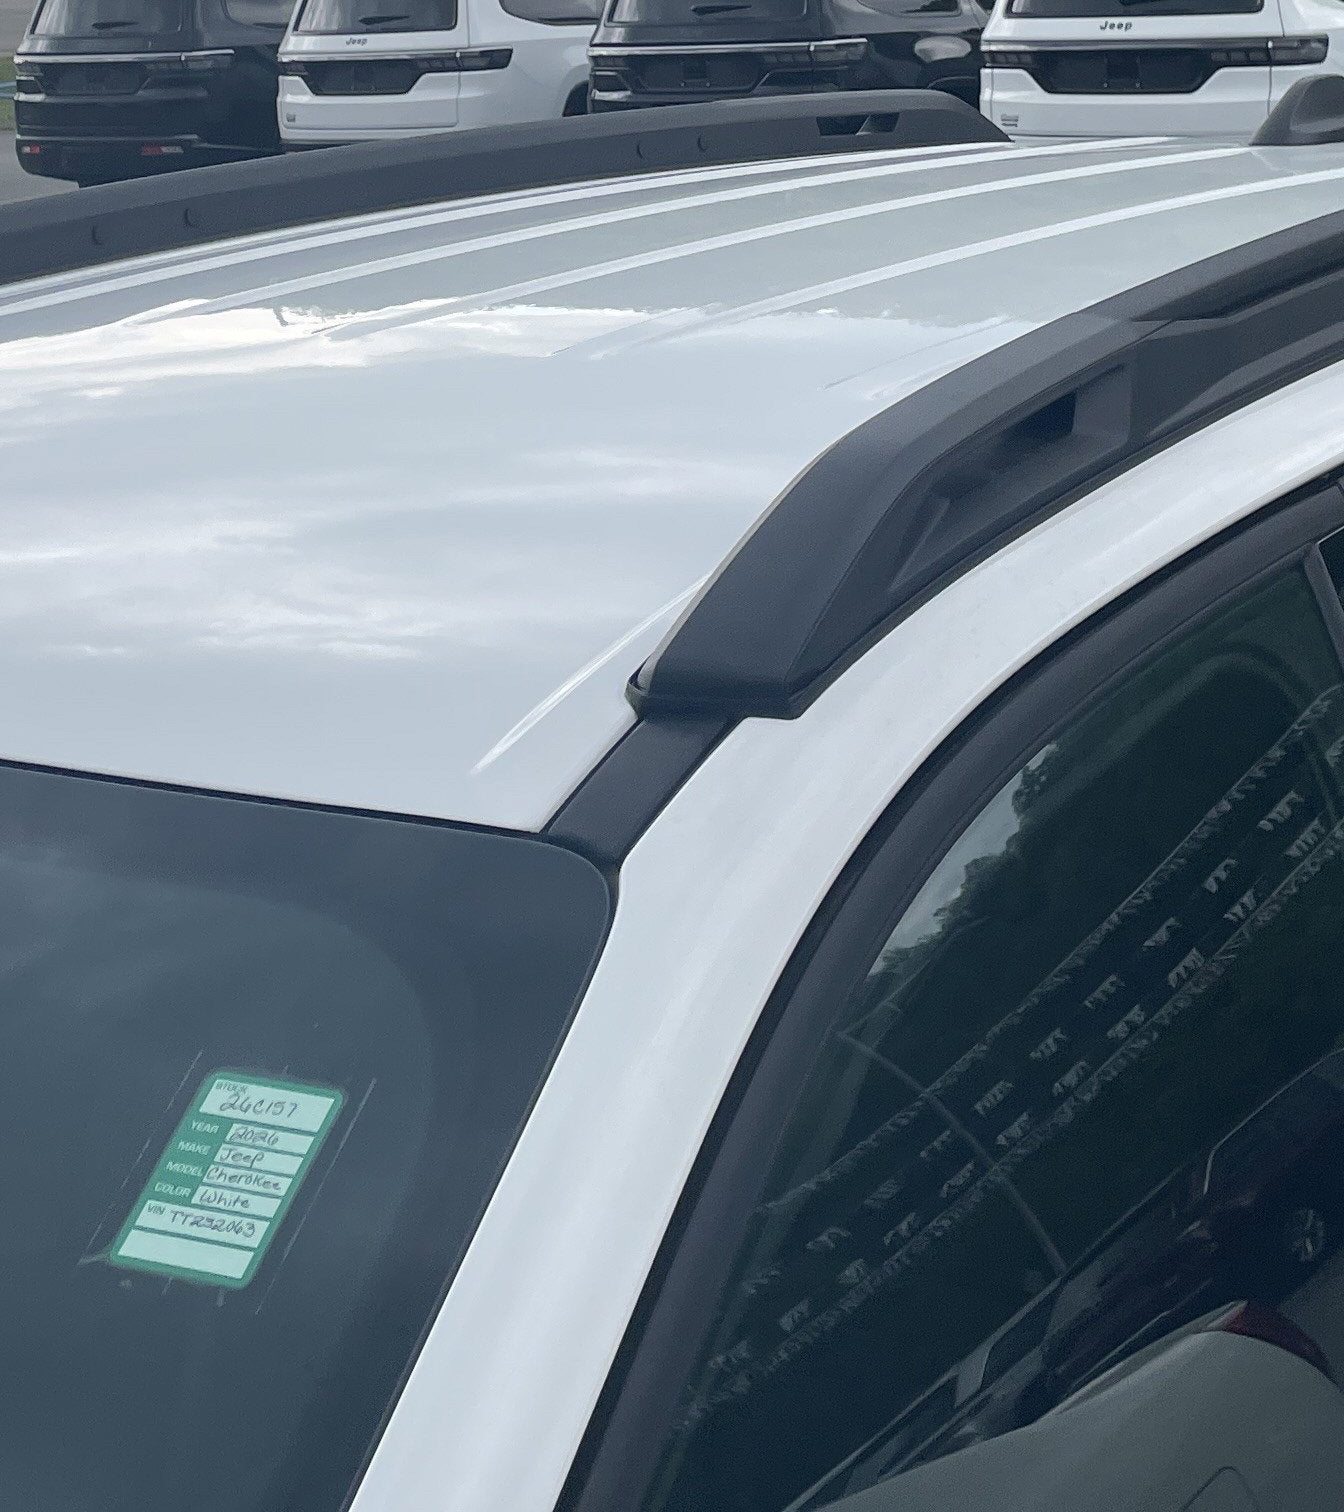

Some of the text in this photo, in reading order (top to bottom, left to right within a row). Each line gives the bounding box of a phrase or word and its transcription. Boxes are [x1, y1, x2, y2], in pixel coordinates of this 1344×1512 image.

[1099, 20, 1133, 32] Jeep
[345, 37, 368, 46] Jeep
[199, 1188, 250, 1208] White
[146, 1203, 166, 1216] VIN
